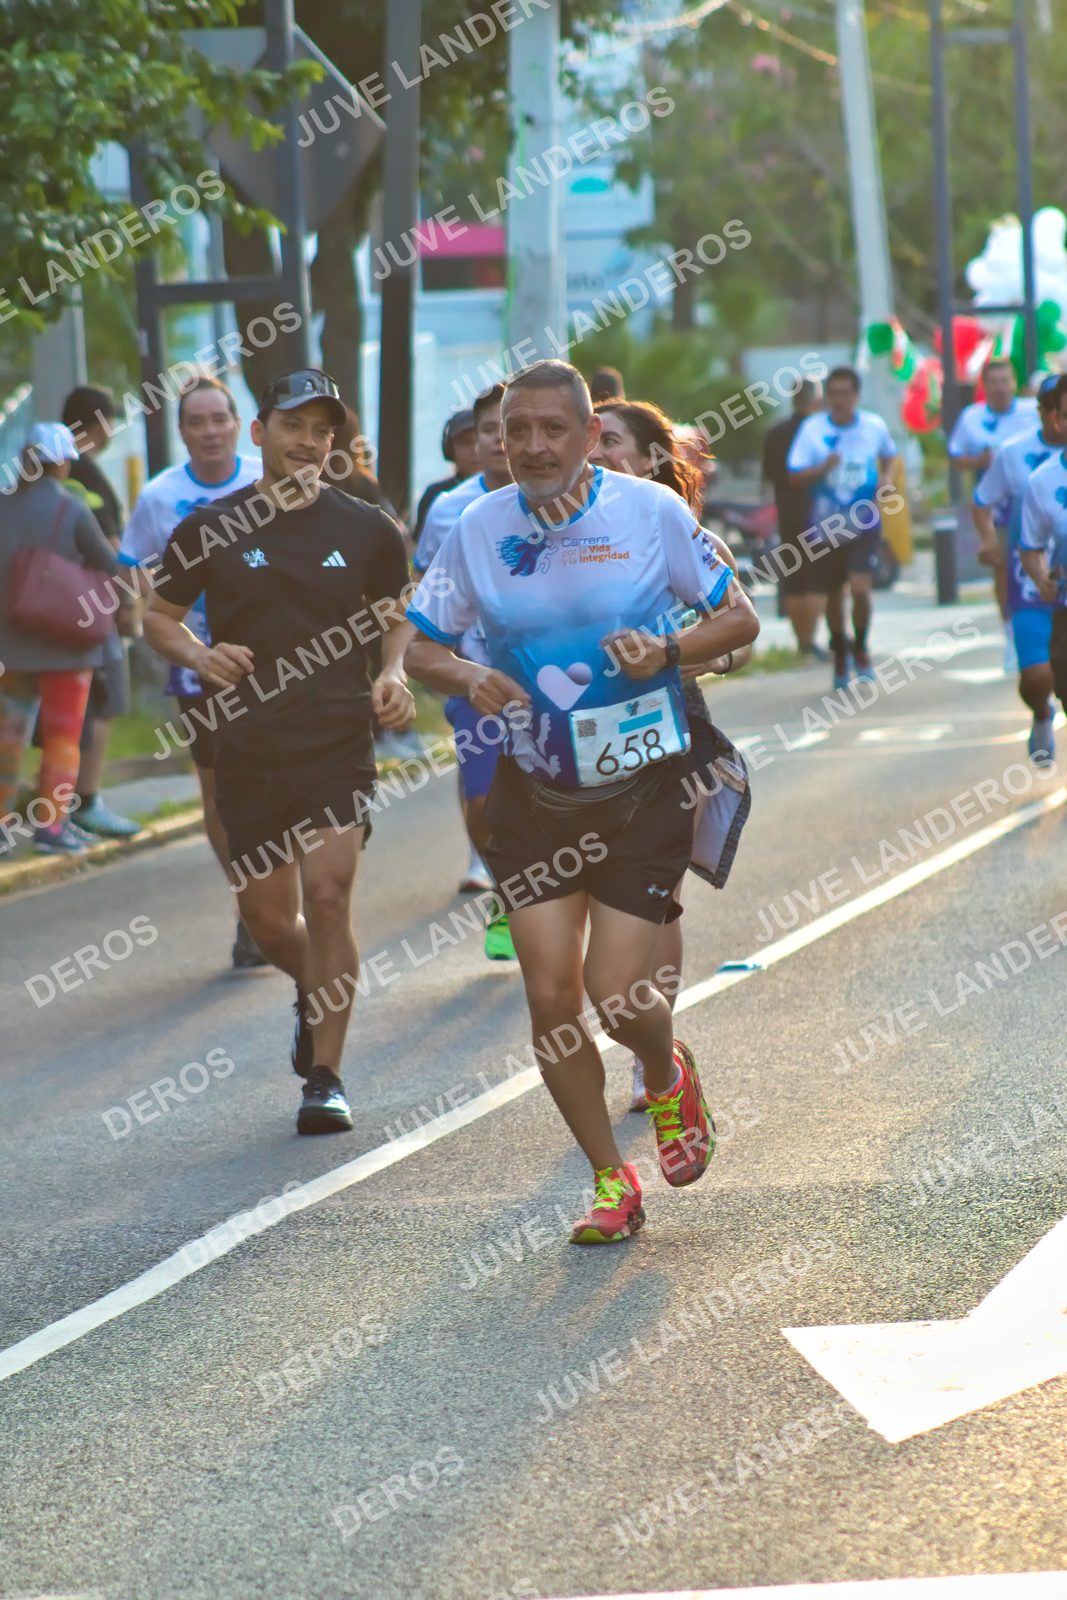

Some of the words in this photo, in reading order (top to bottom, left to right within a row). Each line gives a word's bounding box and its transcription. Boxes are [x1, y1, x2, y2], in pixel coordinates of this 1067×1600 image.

[562, 536, 610, 548] Carrera
[589, 544, 611, 553] Vida
[596, 729, 666, 776] 658
